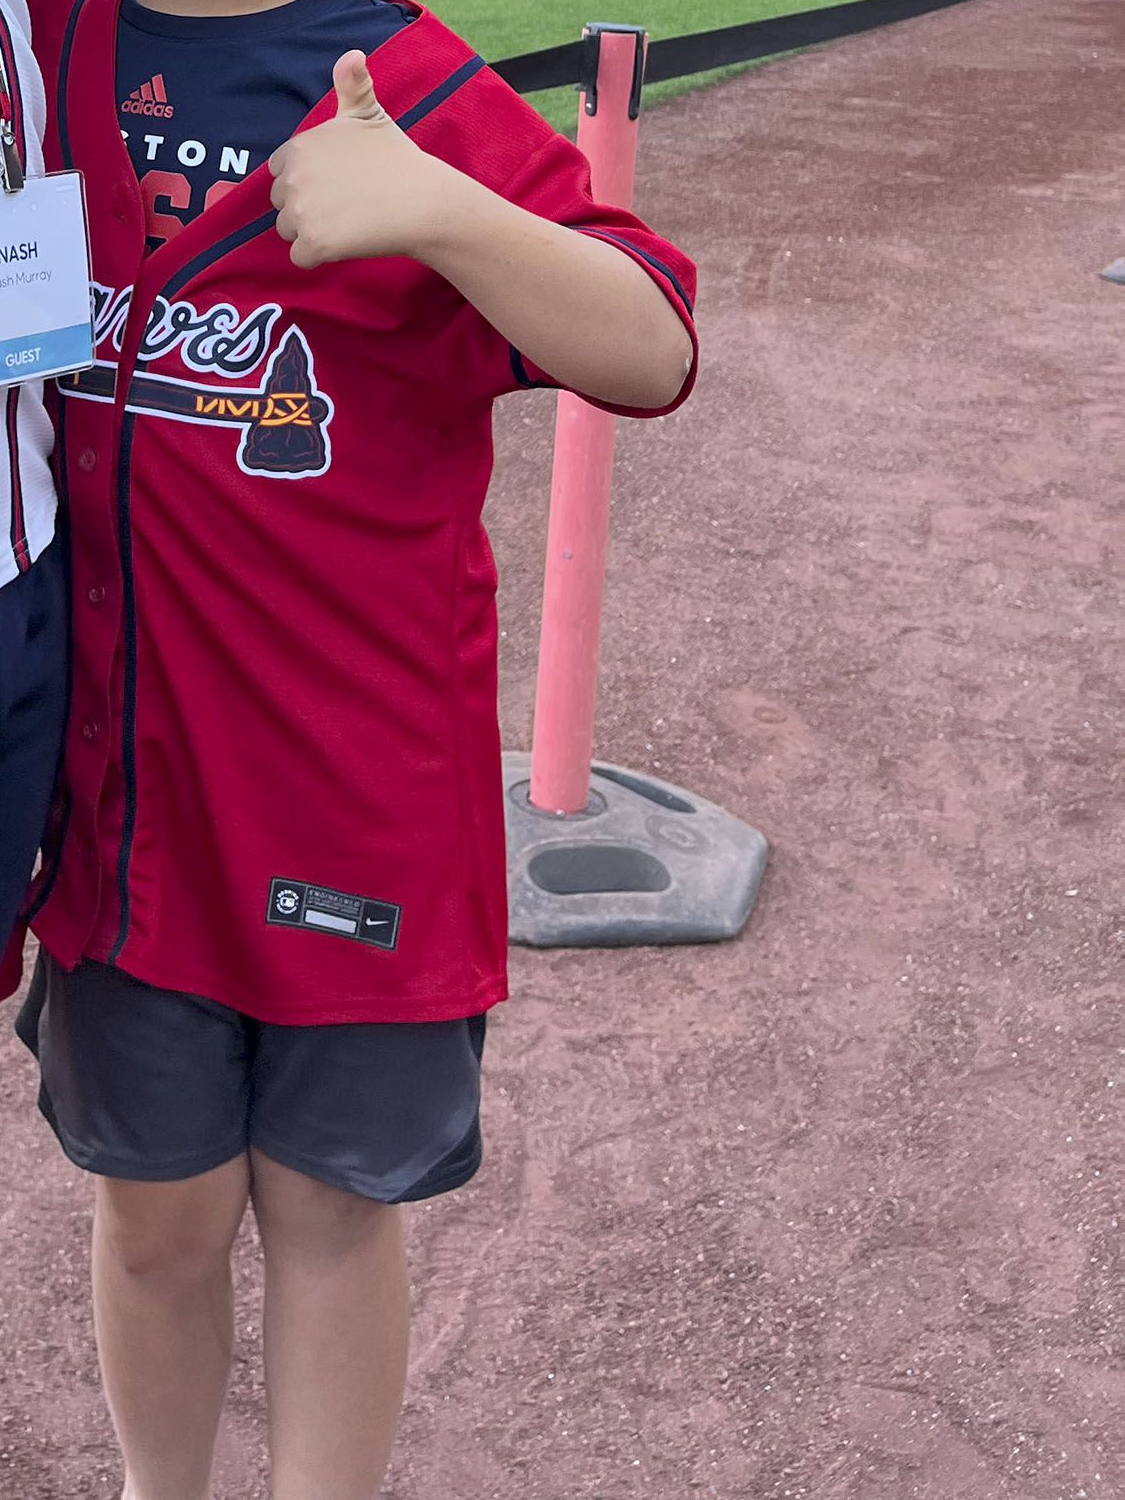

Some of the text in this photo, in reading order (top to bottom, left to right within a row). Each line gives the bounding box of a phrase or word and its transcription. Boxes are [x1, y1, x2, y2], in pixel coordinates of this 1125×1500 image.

[121, 99, 174, 118] adidas
[15, 269, 52, 284] Murray
[5, 347, 41, 367] GUEST
